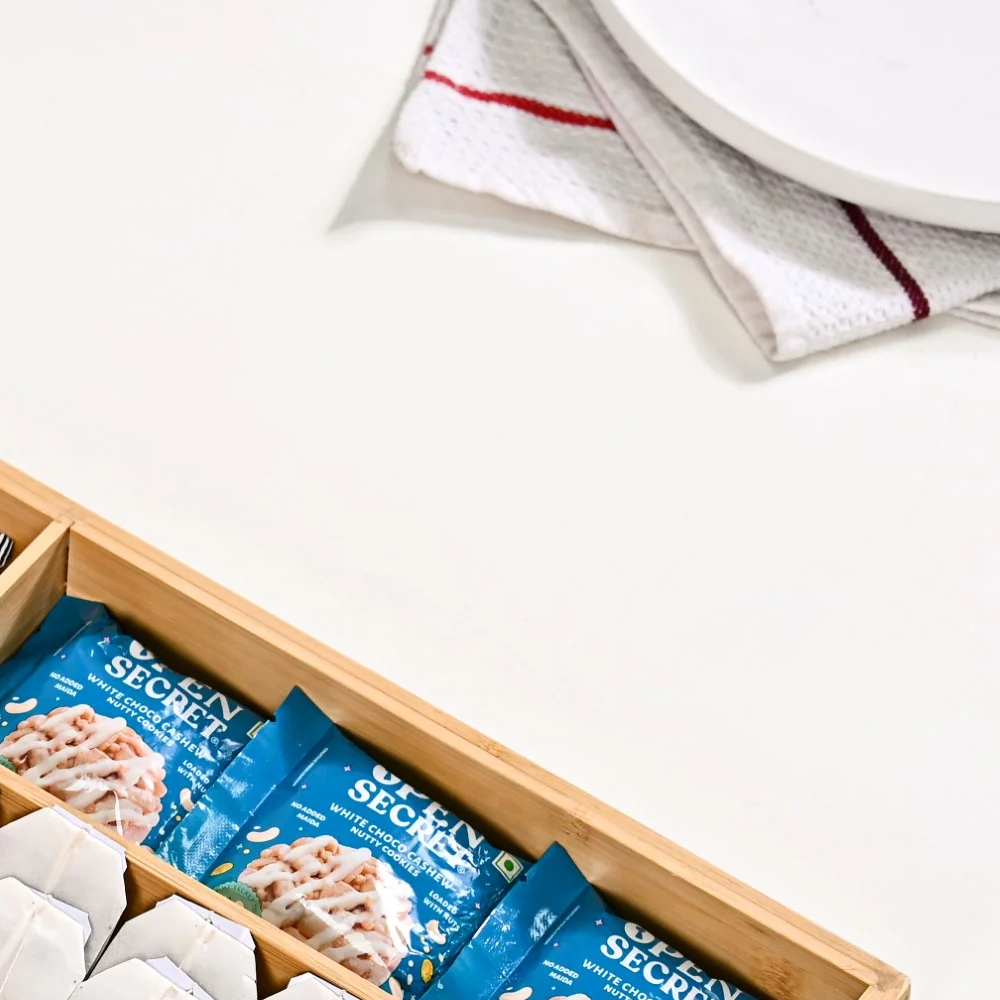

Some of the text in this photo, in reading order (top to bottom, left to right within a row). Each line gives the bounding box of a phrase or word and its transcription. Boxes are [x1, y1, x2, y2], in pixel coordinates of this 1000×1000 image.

[54, 683, 78, 697] MAIDA
[104, 655, 228, 740] SECRET
[87, 672, 206, 760] WHITE CHOCO CASHEW
[106, 696, 176, 747] NUTTY COOKIES
[182, 760, 210, 784] LOADED
[347, 779, 474, 869] SECRET
[329, 802, 455, 891] WHITE CHOCO CASHEW
[350, 826, 422, 878] NUTTY COOKIES
[422, 897, 444, 917] WITH
[428, 889, 458, 915] LOADED
[549, 971, 574, 986] MAIDA
[552, 964, 579, 980] ADDED
[582, 958, 622, 986] WHITE
